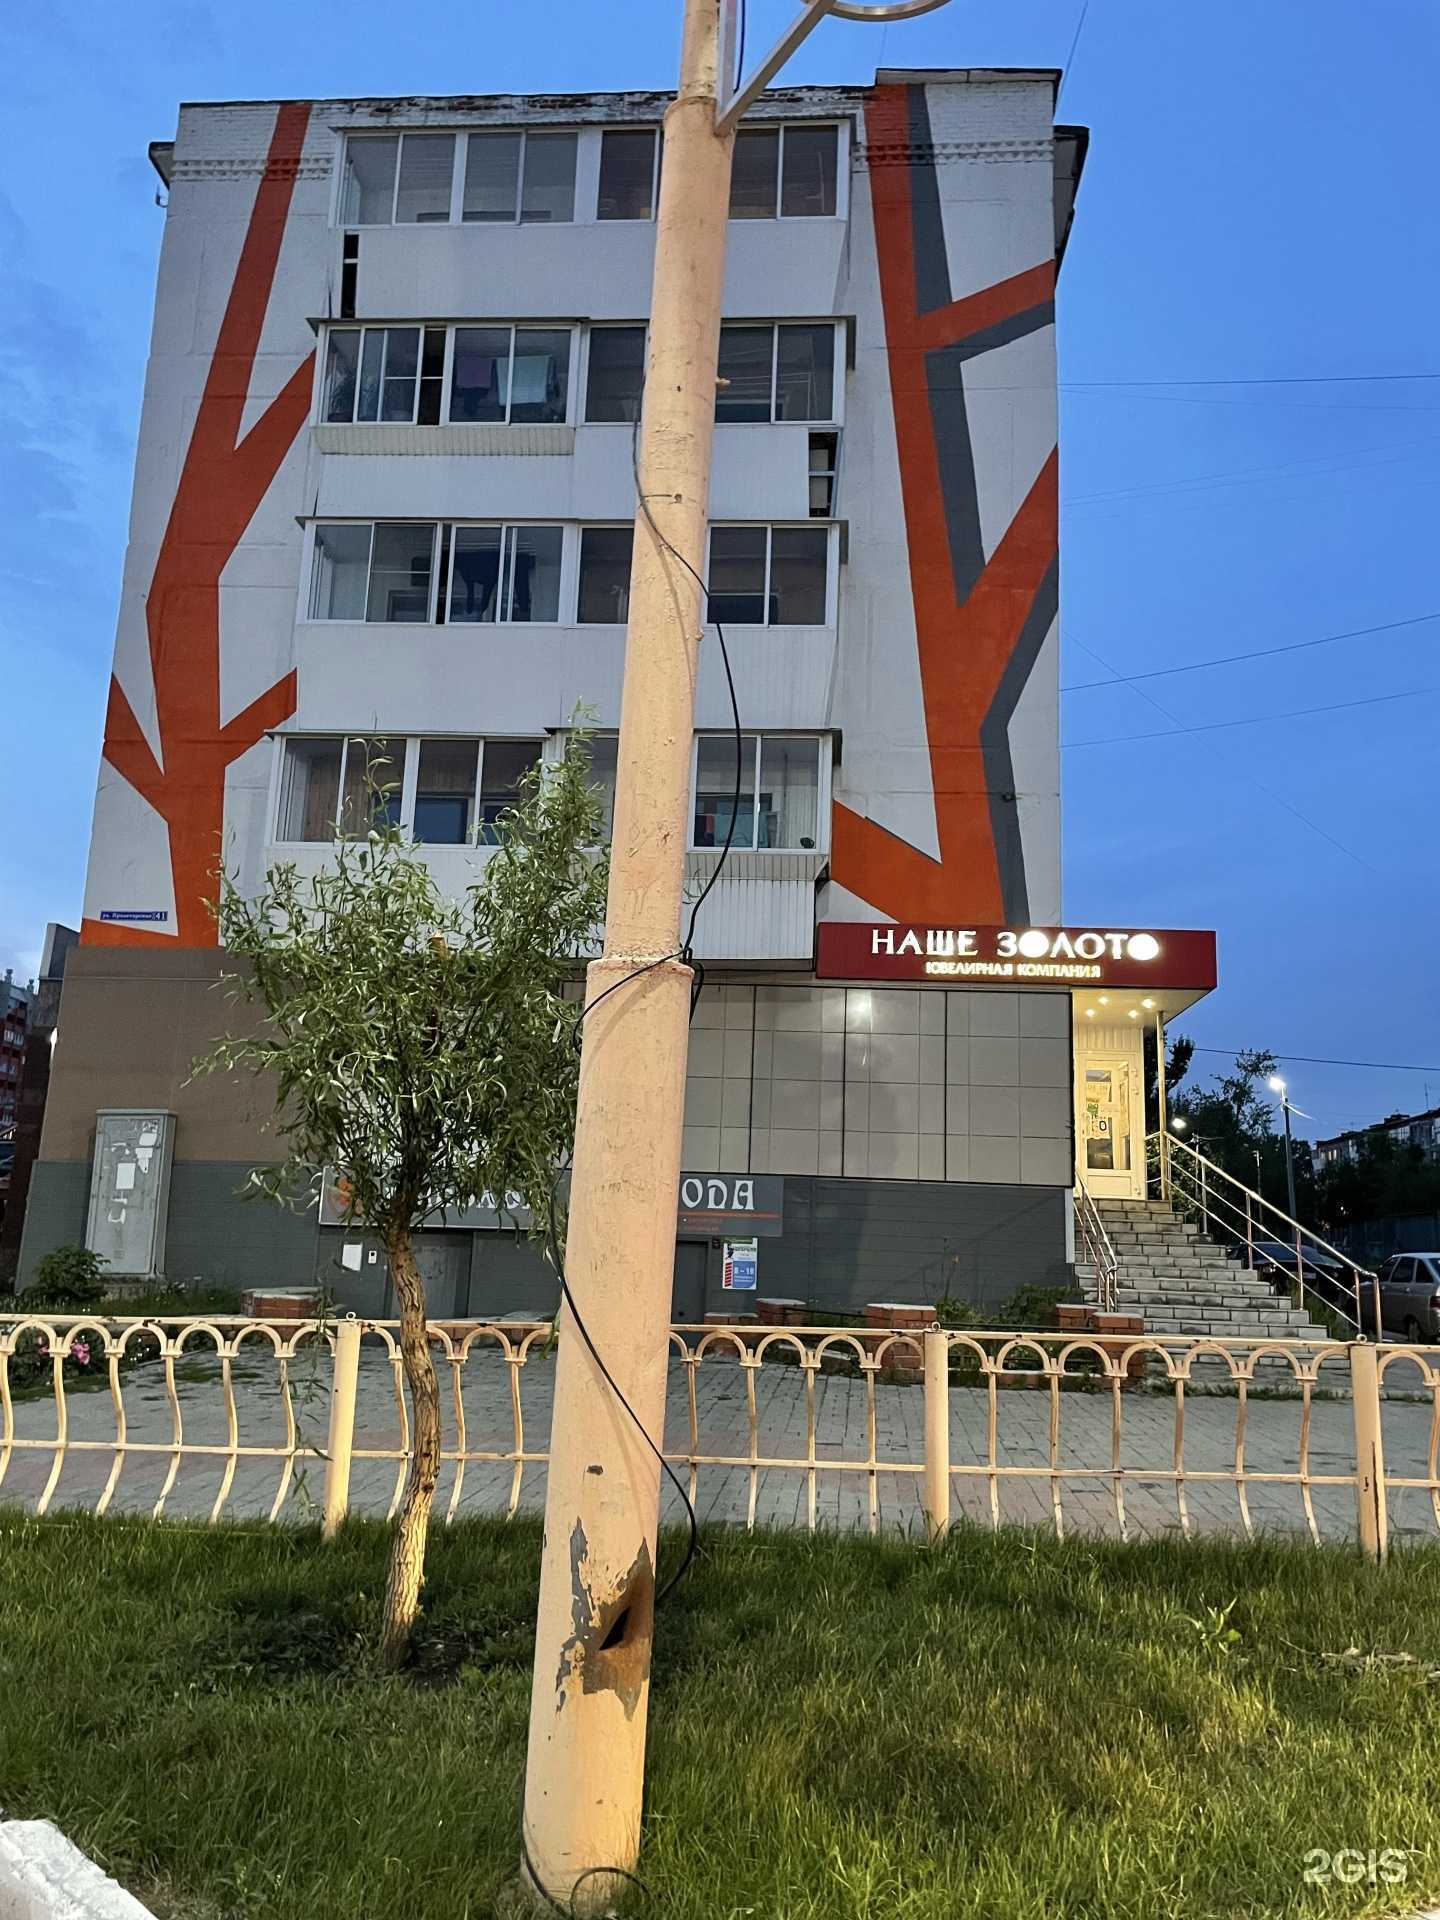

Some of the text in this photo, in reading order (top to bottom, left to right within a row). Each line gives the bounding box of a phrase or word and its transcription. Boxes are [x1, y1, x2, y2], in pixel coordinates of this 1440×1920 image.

[872, 929, 1160, 961] НАШЕ ЗОЛОТО
[925, 961, 1101, 978] ЮВЕЛИРНАЯ КОМПАНИЯ
